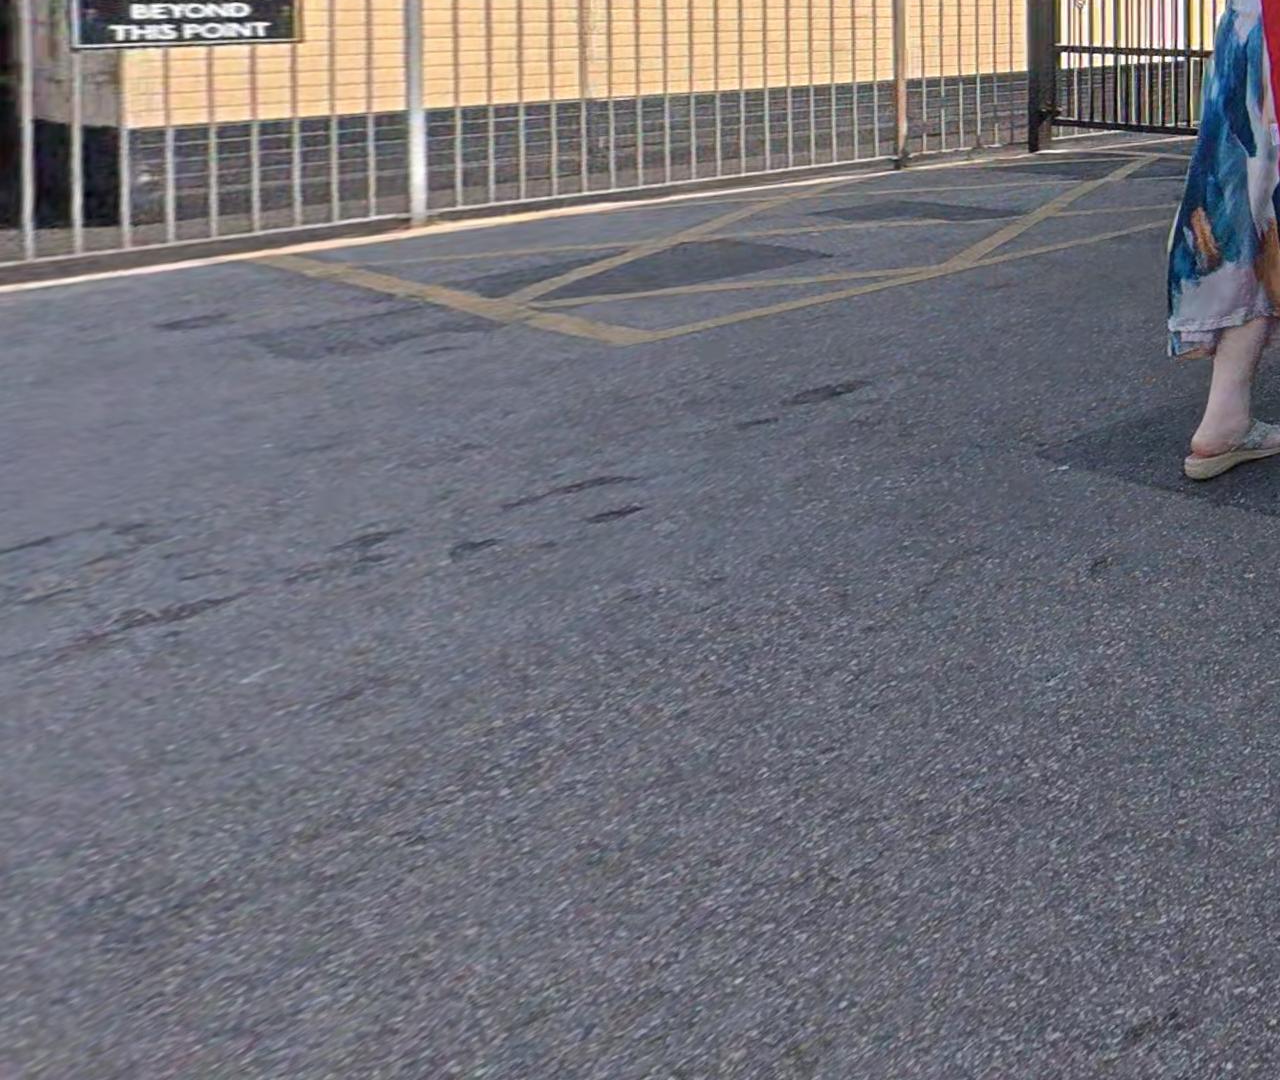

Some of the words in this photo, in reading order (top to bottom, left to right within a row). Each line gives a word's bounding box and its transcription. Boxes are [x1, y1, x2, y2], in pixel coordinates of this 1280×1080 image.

[129, 2, 252, 20] BEYOND
[109, 24, 177, 41] THIS
[182, 22, 272, 39] POINT
